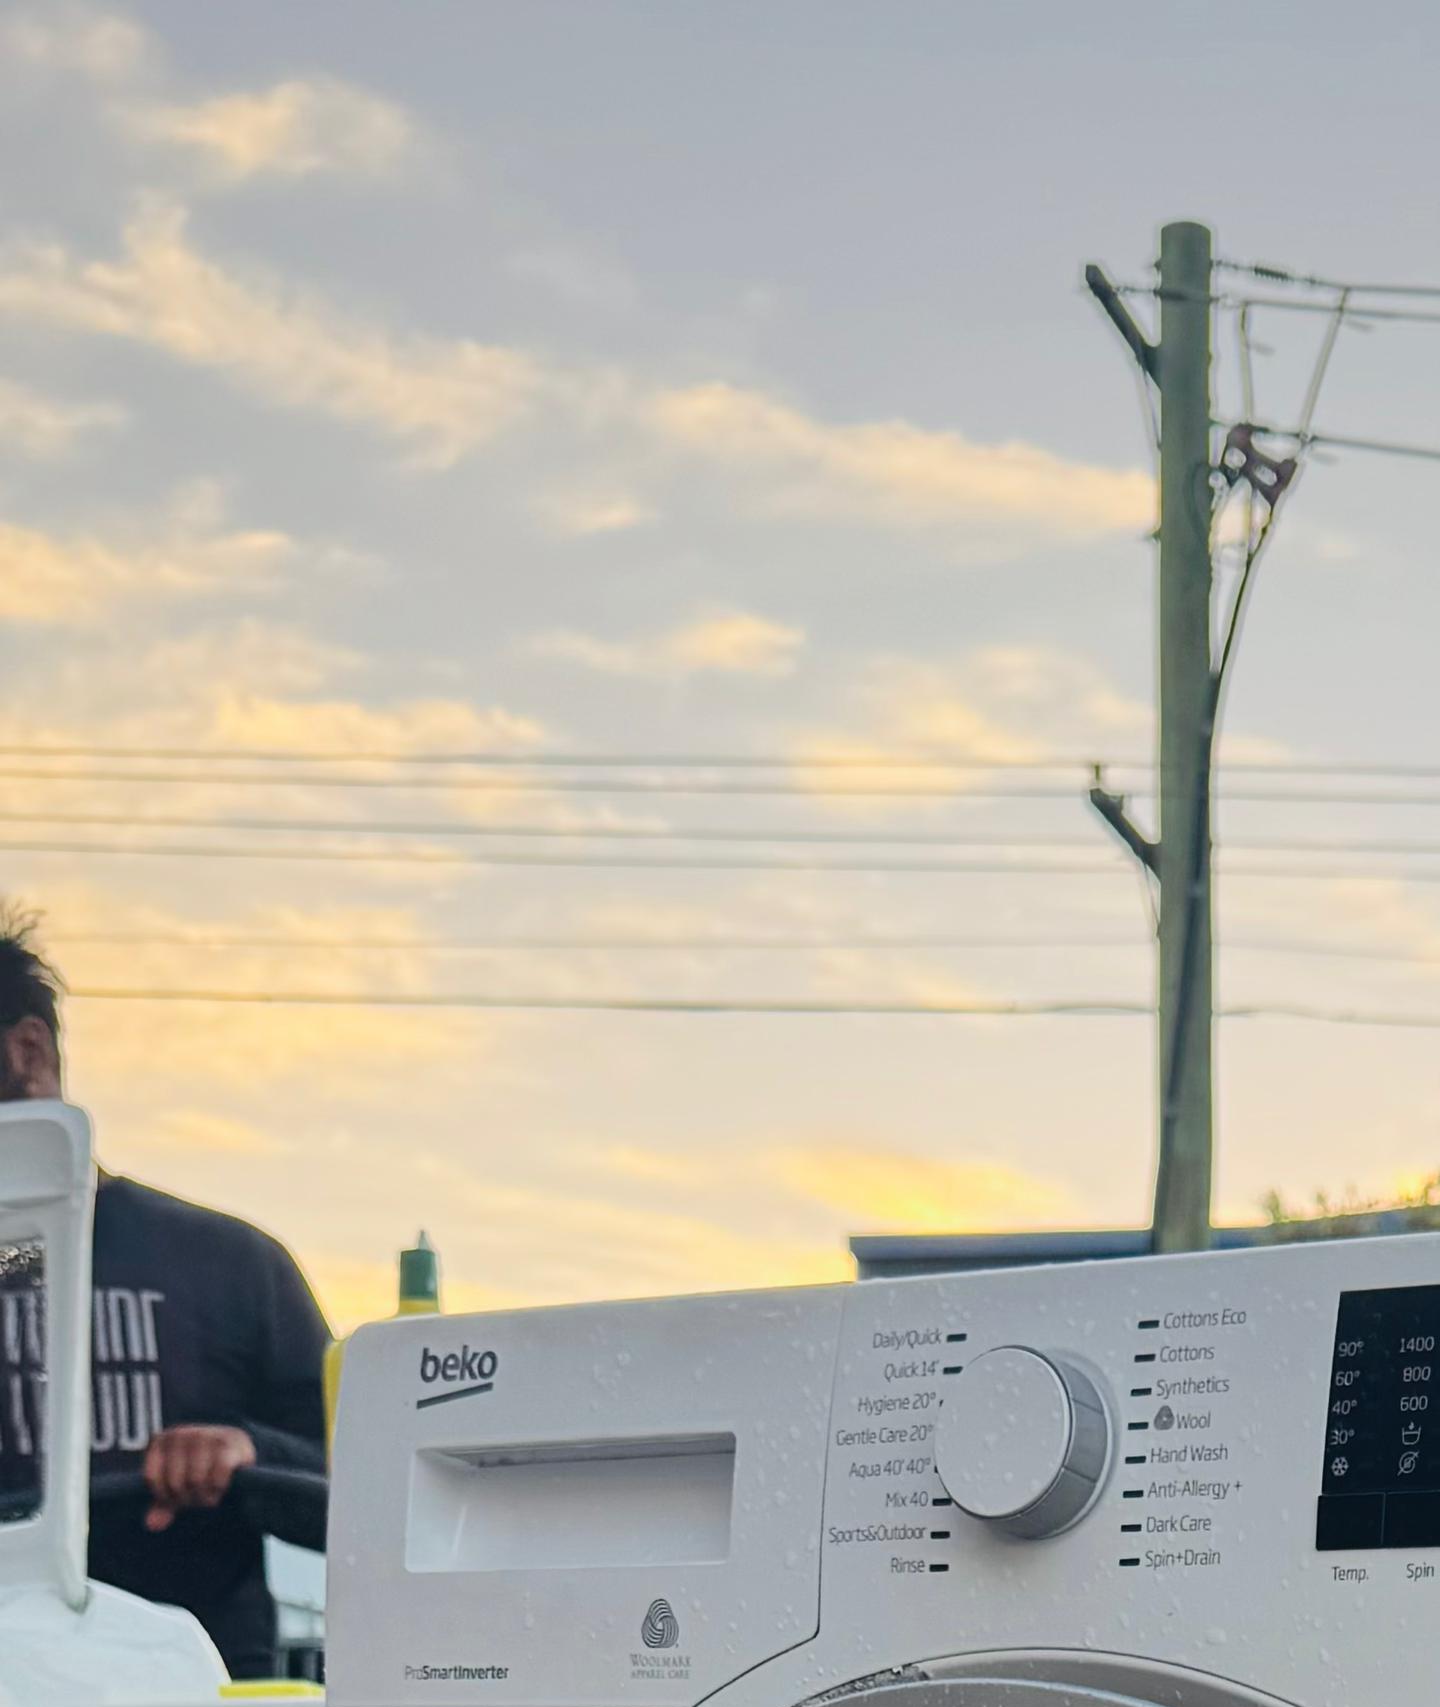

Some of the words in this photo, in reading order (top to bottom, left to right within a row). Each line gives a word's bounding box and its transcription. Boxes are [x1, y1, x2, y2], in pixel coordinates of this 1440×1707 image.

[1163, 1311, 1219, 1330] Cottons
[1221, 1309, 1247, 1326] Eco
[872, 1330, 942, 1350] Daily/Quick
[1399, 1336, 1435, 1353] 1400
[1160, 1344, 1215, 1363] Cottons
[420, 1345, 498, 1383] beko
[883, 1362, 920, 1382] Quick
[1402, 1366, 1431, 1383] 800
[1156, 1376, 1230, 1398] Synthetics
[857, 1396, 910, 1416] Hygiene
[1400, 1395, 1428, 1412] 600
[1176, 1412, 1211, 1430] Wool
[836, 1429, 878, 1447] Gentle
[879, 1426, 908, 1444] Care
[1150, 1447, 1187, 1464] Hand
[1189, 1445, 1229, 1462] Wash
[849, 1462, 883, 1480] Aqua
[885, 1493, 908, 1508] Mix
[1147, 1479, 1231, 1503] Anti-Allergy
[1146, 1516, 1180, 1533] Dark
[1181, 1515, 1212, 1532] Care
[828, 1524, 926, 1545] Sports&Outdoor
[890, 1558, 926, 1574] Rinse
[1145, 1549, 1221, 1569] Spin+Drain
[1331, 1565, 1369, 1586] Temp.
[1406, 1561, 1435, 1582] Spin
[404, 1664, 510, 1682] ProSmartInverter
